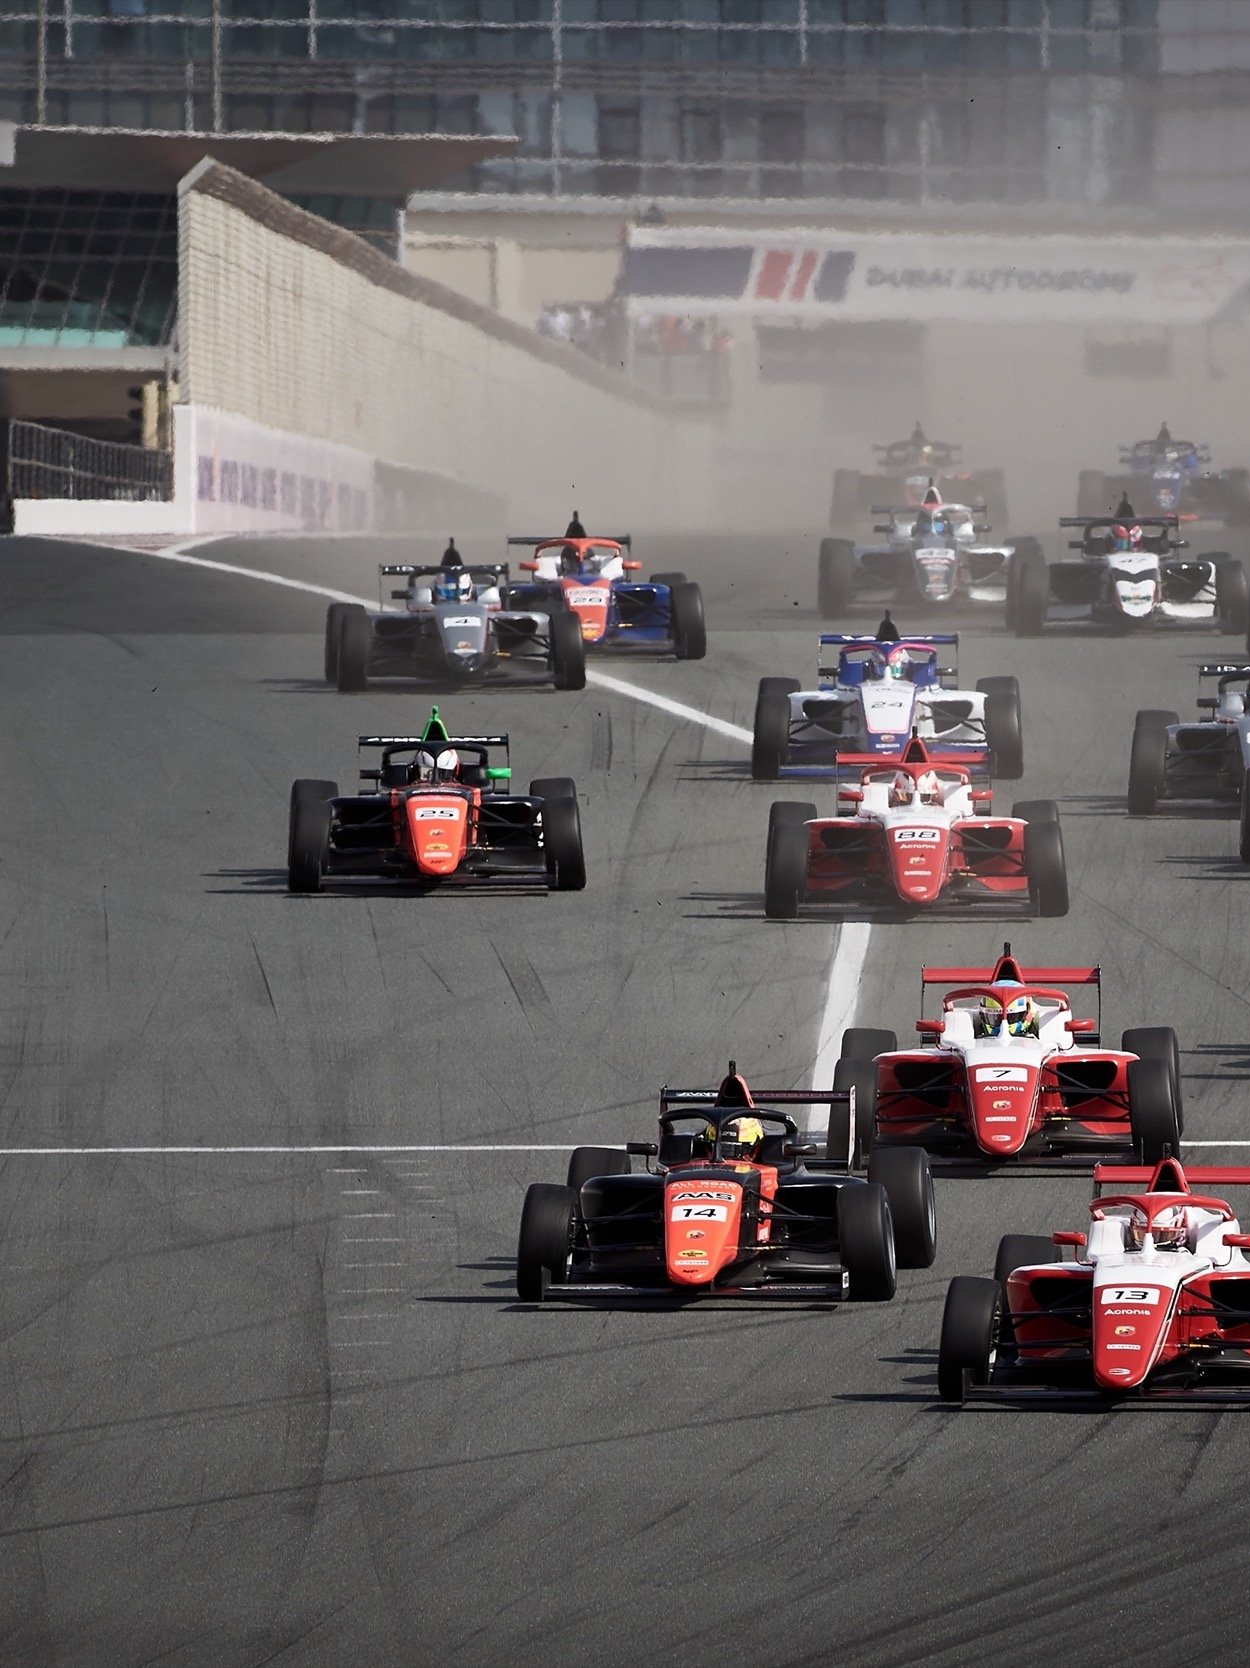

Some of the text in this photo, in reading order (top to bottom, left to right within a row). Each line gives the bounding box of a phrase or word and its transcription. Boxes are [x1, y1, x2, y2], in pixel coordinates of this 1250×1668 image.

[992, 1069, 1012, 1078] 7
[682, 1208, 717, 1218] 14
[1114, 1291, 1149, 1300] 13
[1104, 1308, 1152, 1316] Acronis
